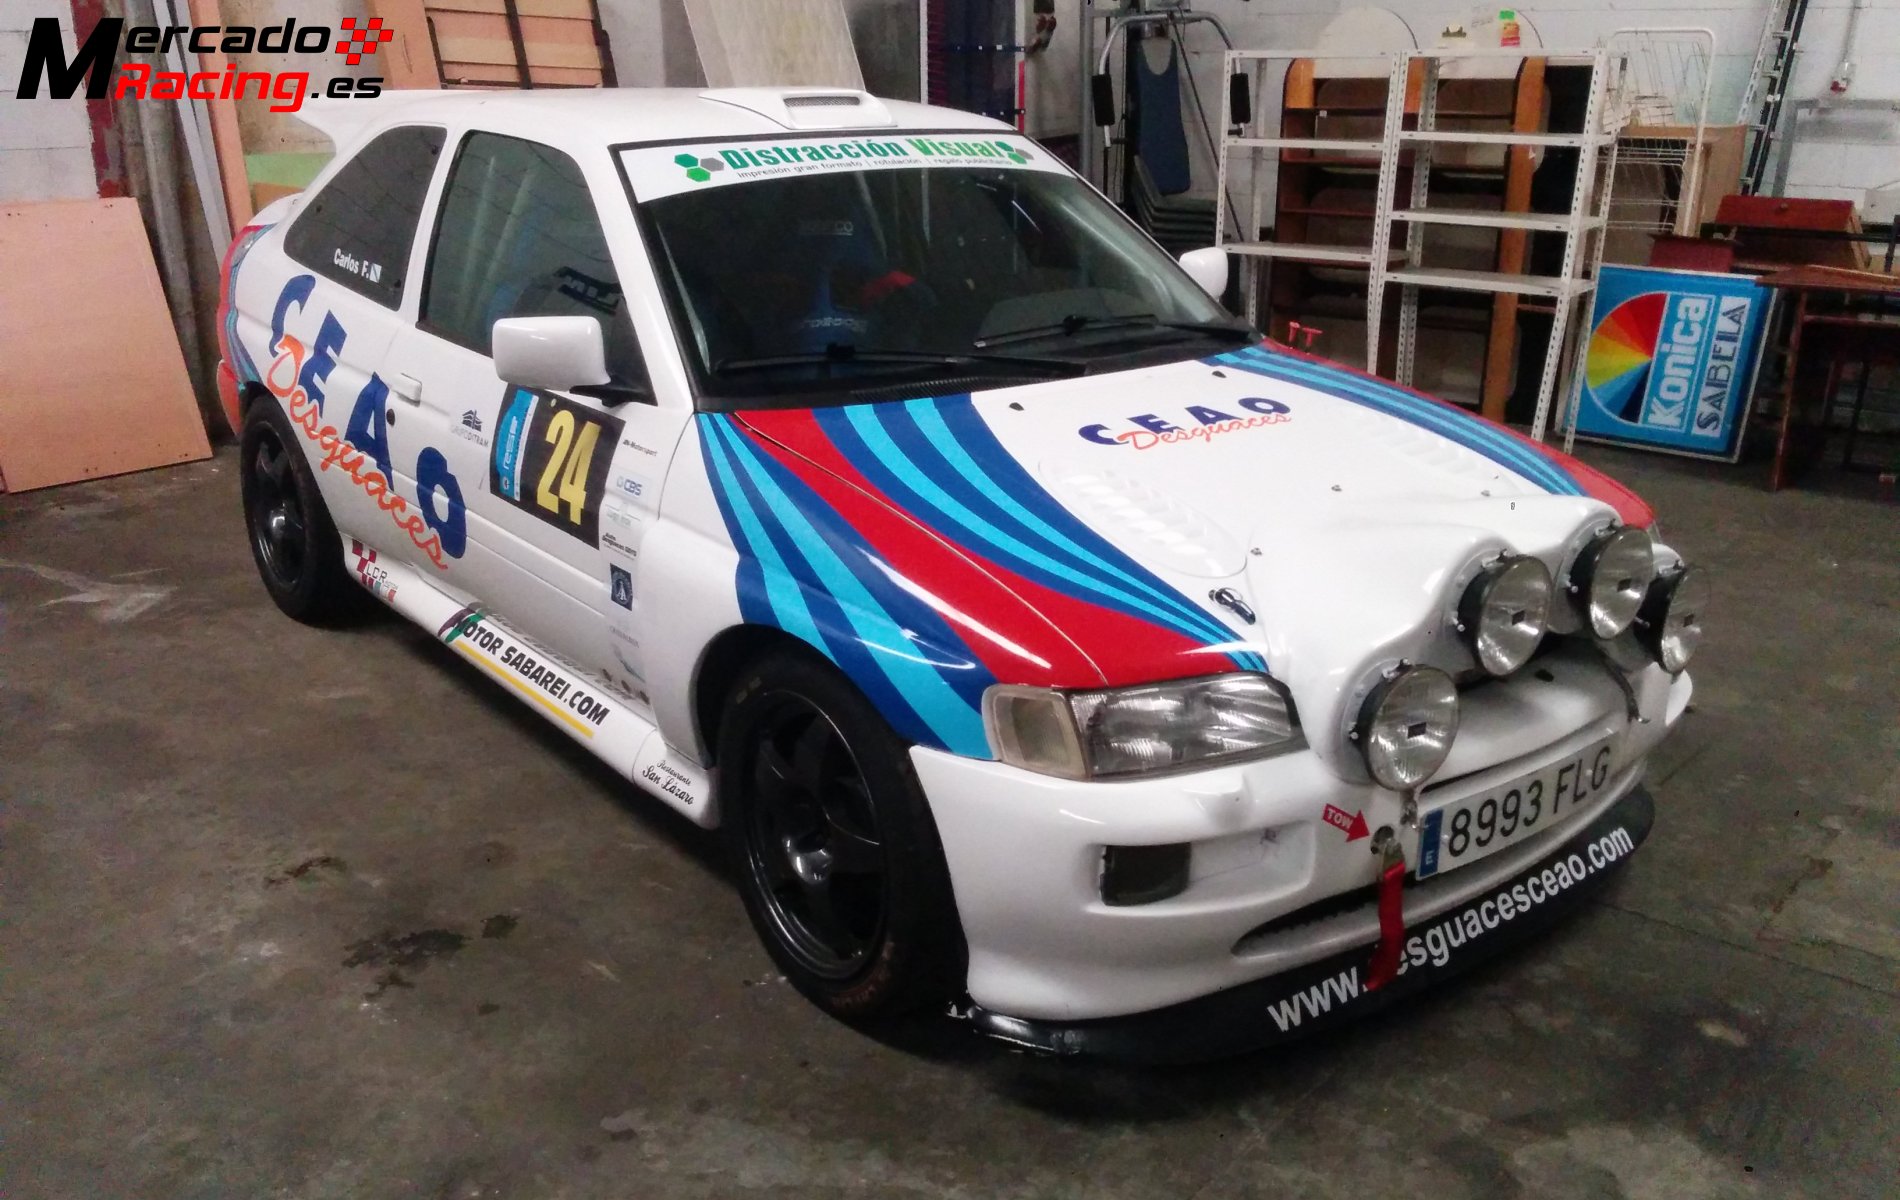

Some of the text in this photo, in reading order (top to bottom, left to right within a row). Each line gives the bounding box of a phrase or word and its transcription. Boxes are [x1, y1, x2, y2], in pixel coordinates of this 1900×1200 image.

[719, 137, 1005, 170] Distracción Visual
[794, 164, 819, 174] gran
[820, 160, 863, 170] formato
[334, 248, 369, 279] Carlos F.
[1648, 297, 1710, 427] Konica
[1696, 304, 1747, 431] SABELA
[269, 274, 467, 560] CEAO
[1078, 397, 1291, 445] CEAO
[1117, 412, 1291, 450] Desguaces
[267, 334, 449, 570] Desguaces
[537, 409, 602, 526] 24
[500, 645, 611, 726] SABAREI.COM
[642, 765, 661, 785] San
[1448, 746, 1612, 858] 8993 FLG
[1327, 808, 1354, 829] TOW
[1425, 850, 1435, 865] E
[1266, 824, 1634, 1032] www.sguacesceao.com
